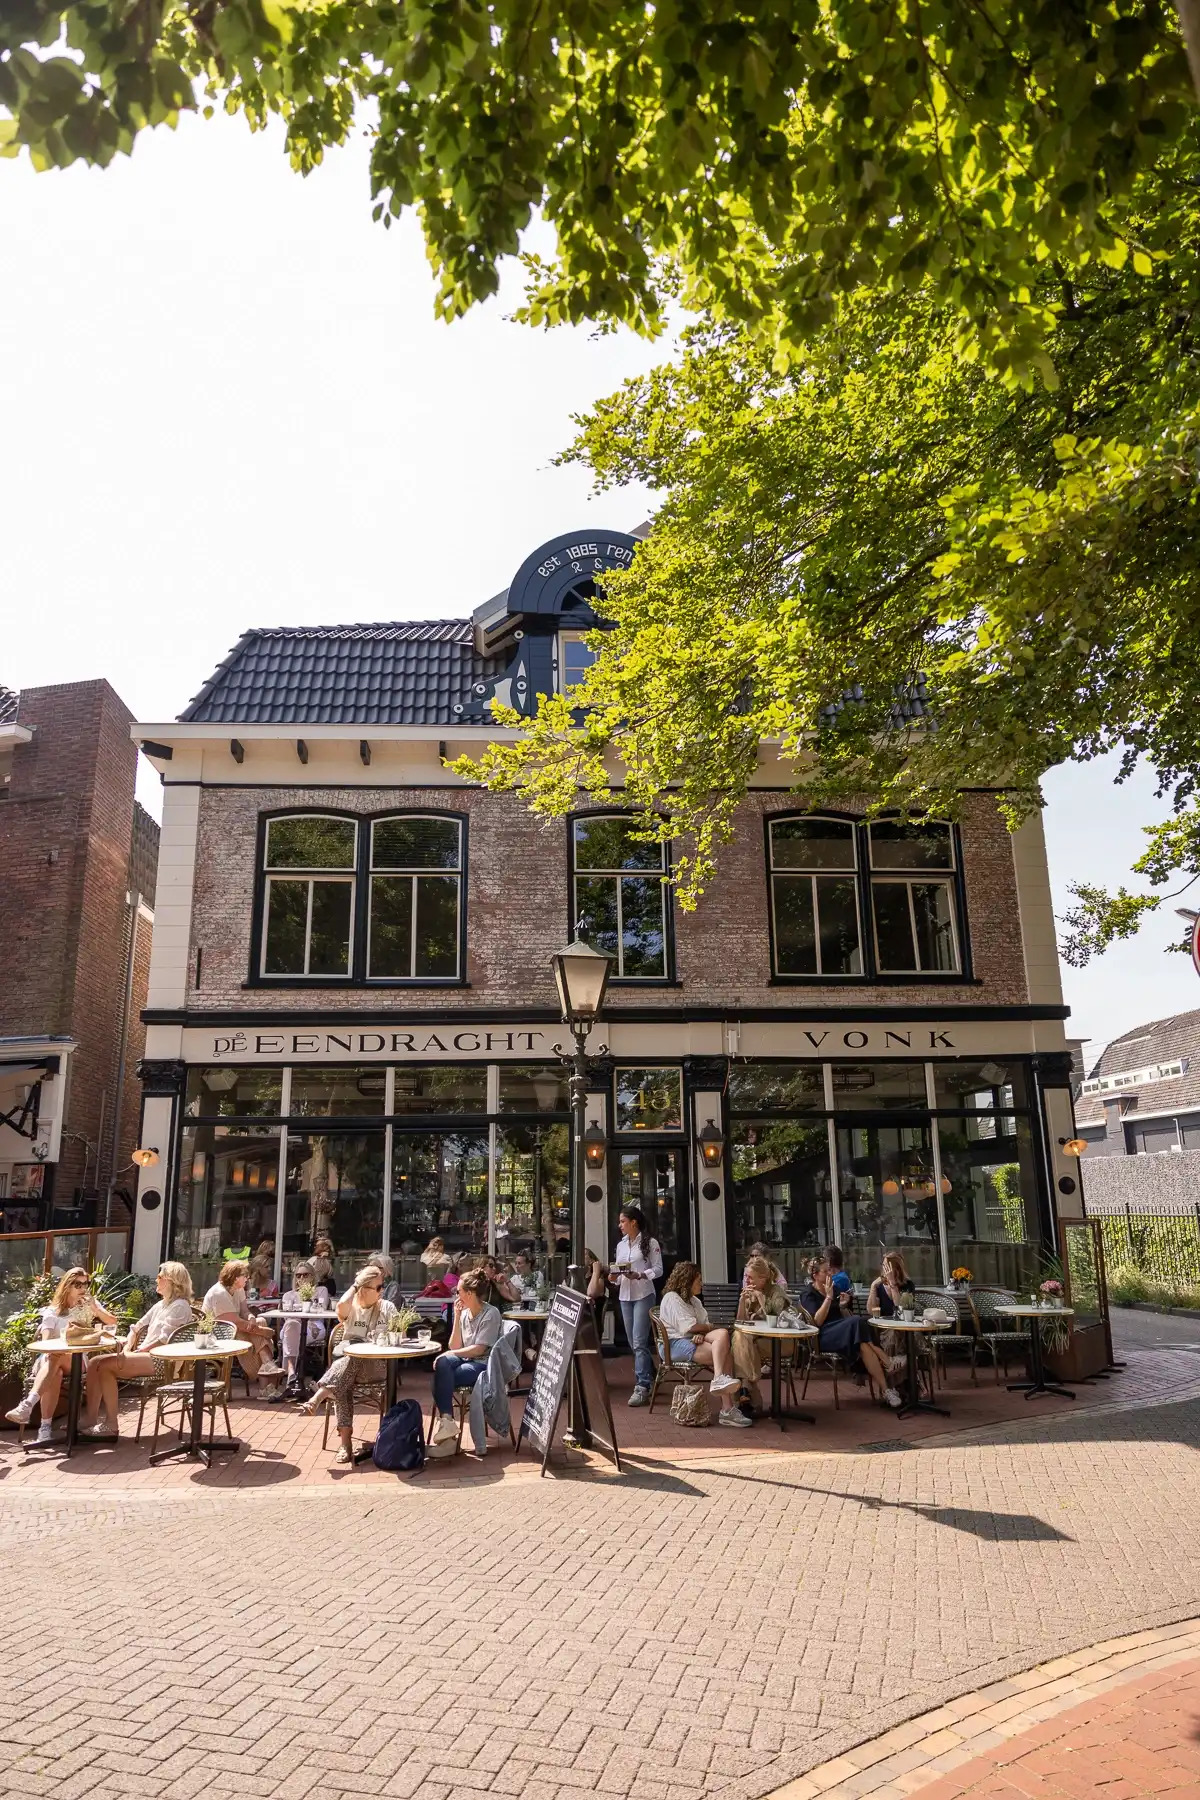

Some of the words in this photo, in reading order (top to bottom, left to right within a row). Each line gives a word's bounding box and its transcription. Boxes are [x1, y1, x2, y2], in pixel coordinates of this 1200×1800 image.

[538, 556, 561, 577] est
[566, 543, 598, 559] 1885
[571, 561, 583, 573] R
[594, 558, 603, 569] &
[213, 1037, 248, 1053] DE
[254, 1032, 545, 1054] EENDRAGHT
[802, 1031, 957, 1049] VONK
[627, 1088, 671, 1110] 43
